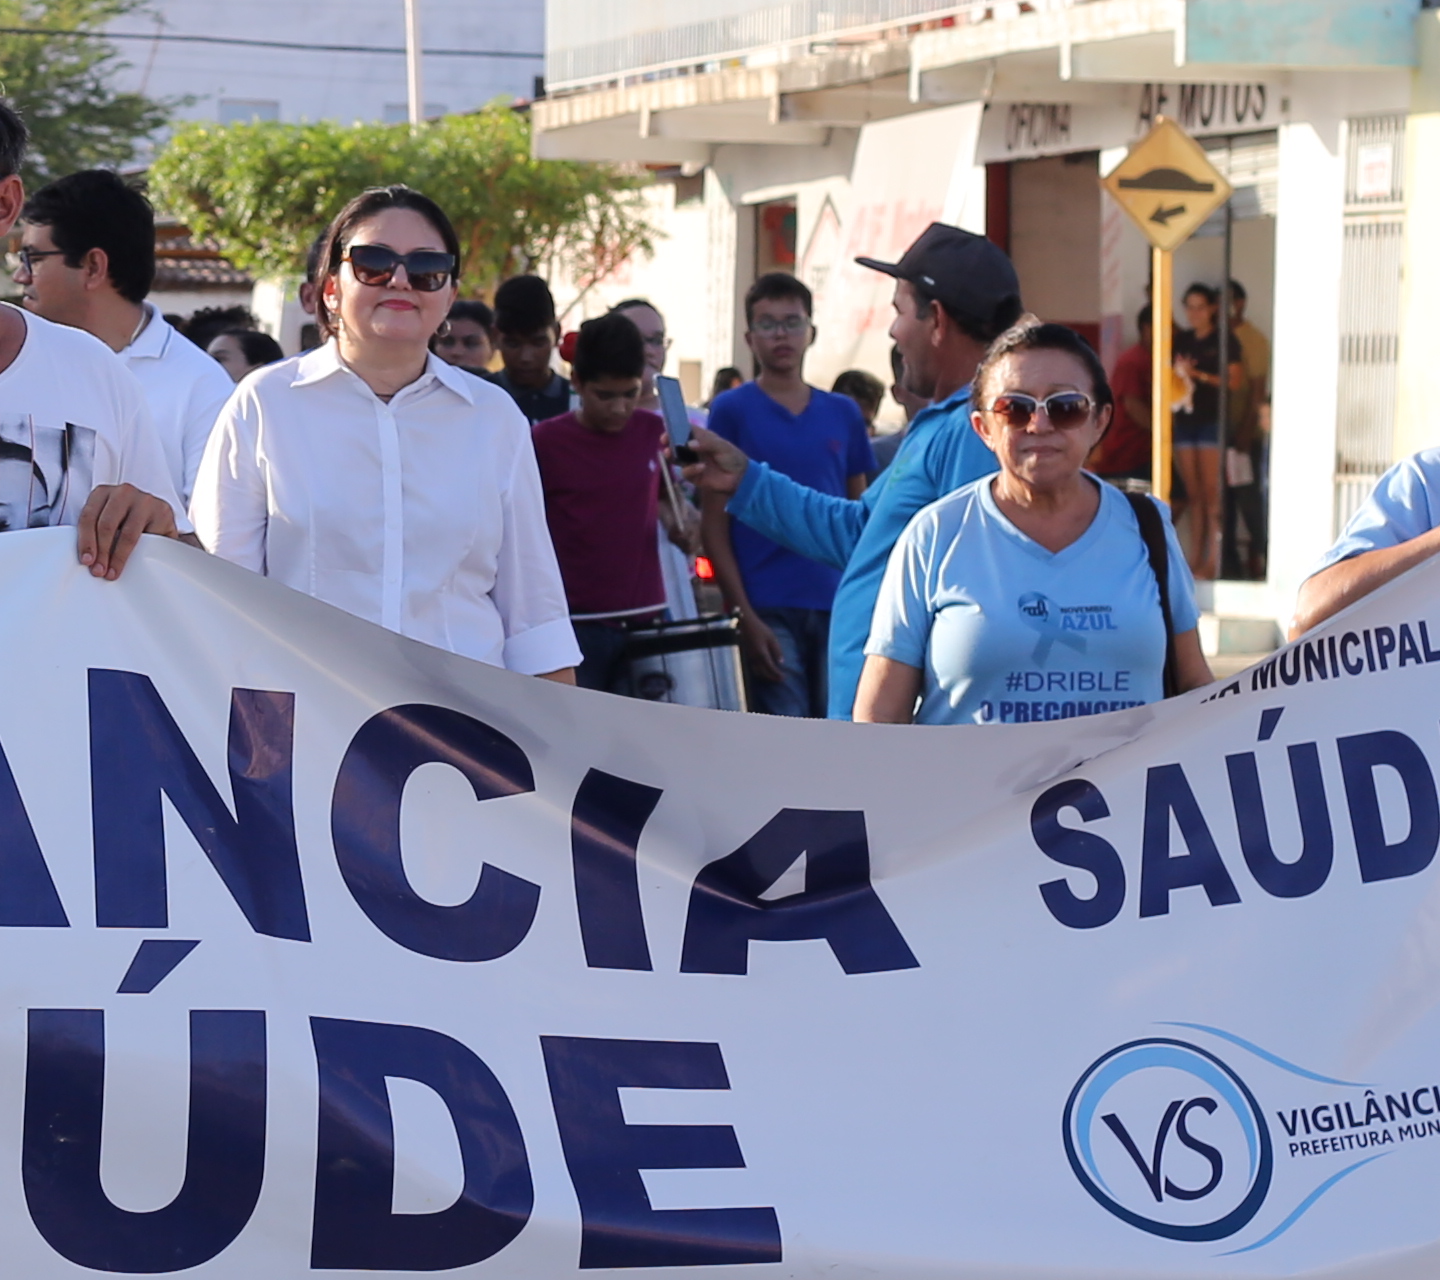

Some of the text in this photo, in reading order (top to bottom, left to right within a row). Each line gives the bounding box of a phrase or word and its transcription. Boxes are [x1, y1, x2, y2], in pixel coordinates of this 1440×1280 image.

[1060, 605, 1113, 613] NOVEMBRO
[1061, 614, 1118, 632] AZUL
[1005, 670, 1132, 693] #DRIBLE
[1101, 1095, 1224, 1204] VS
[1288, 1127, 1395, 1159] PREFEITURA
